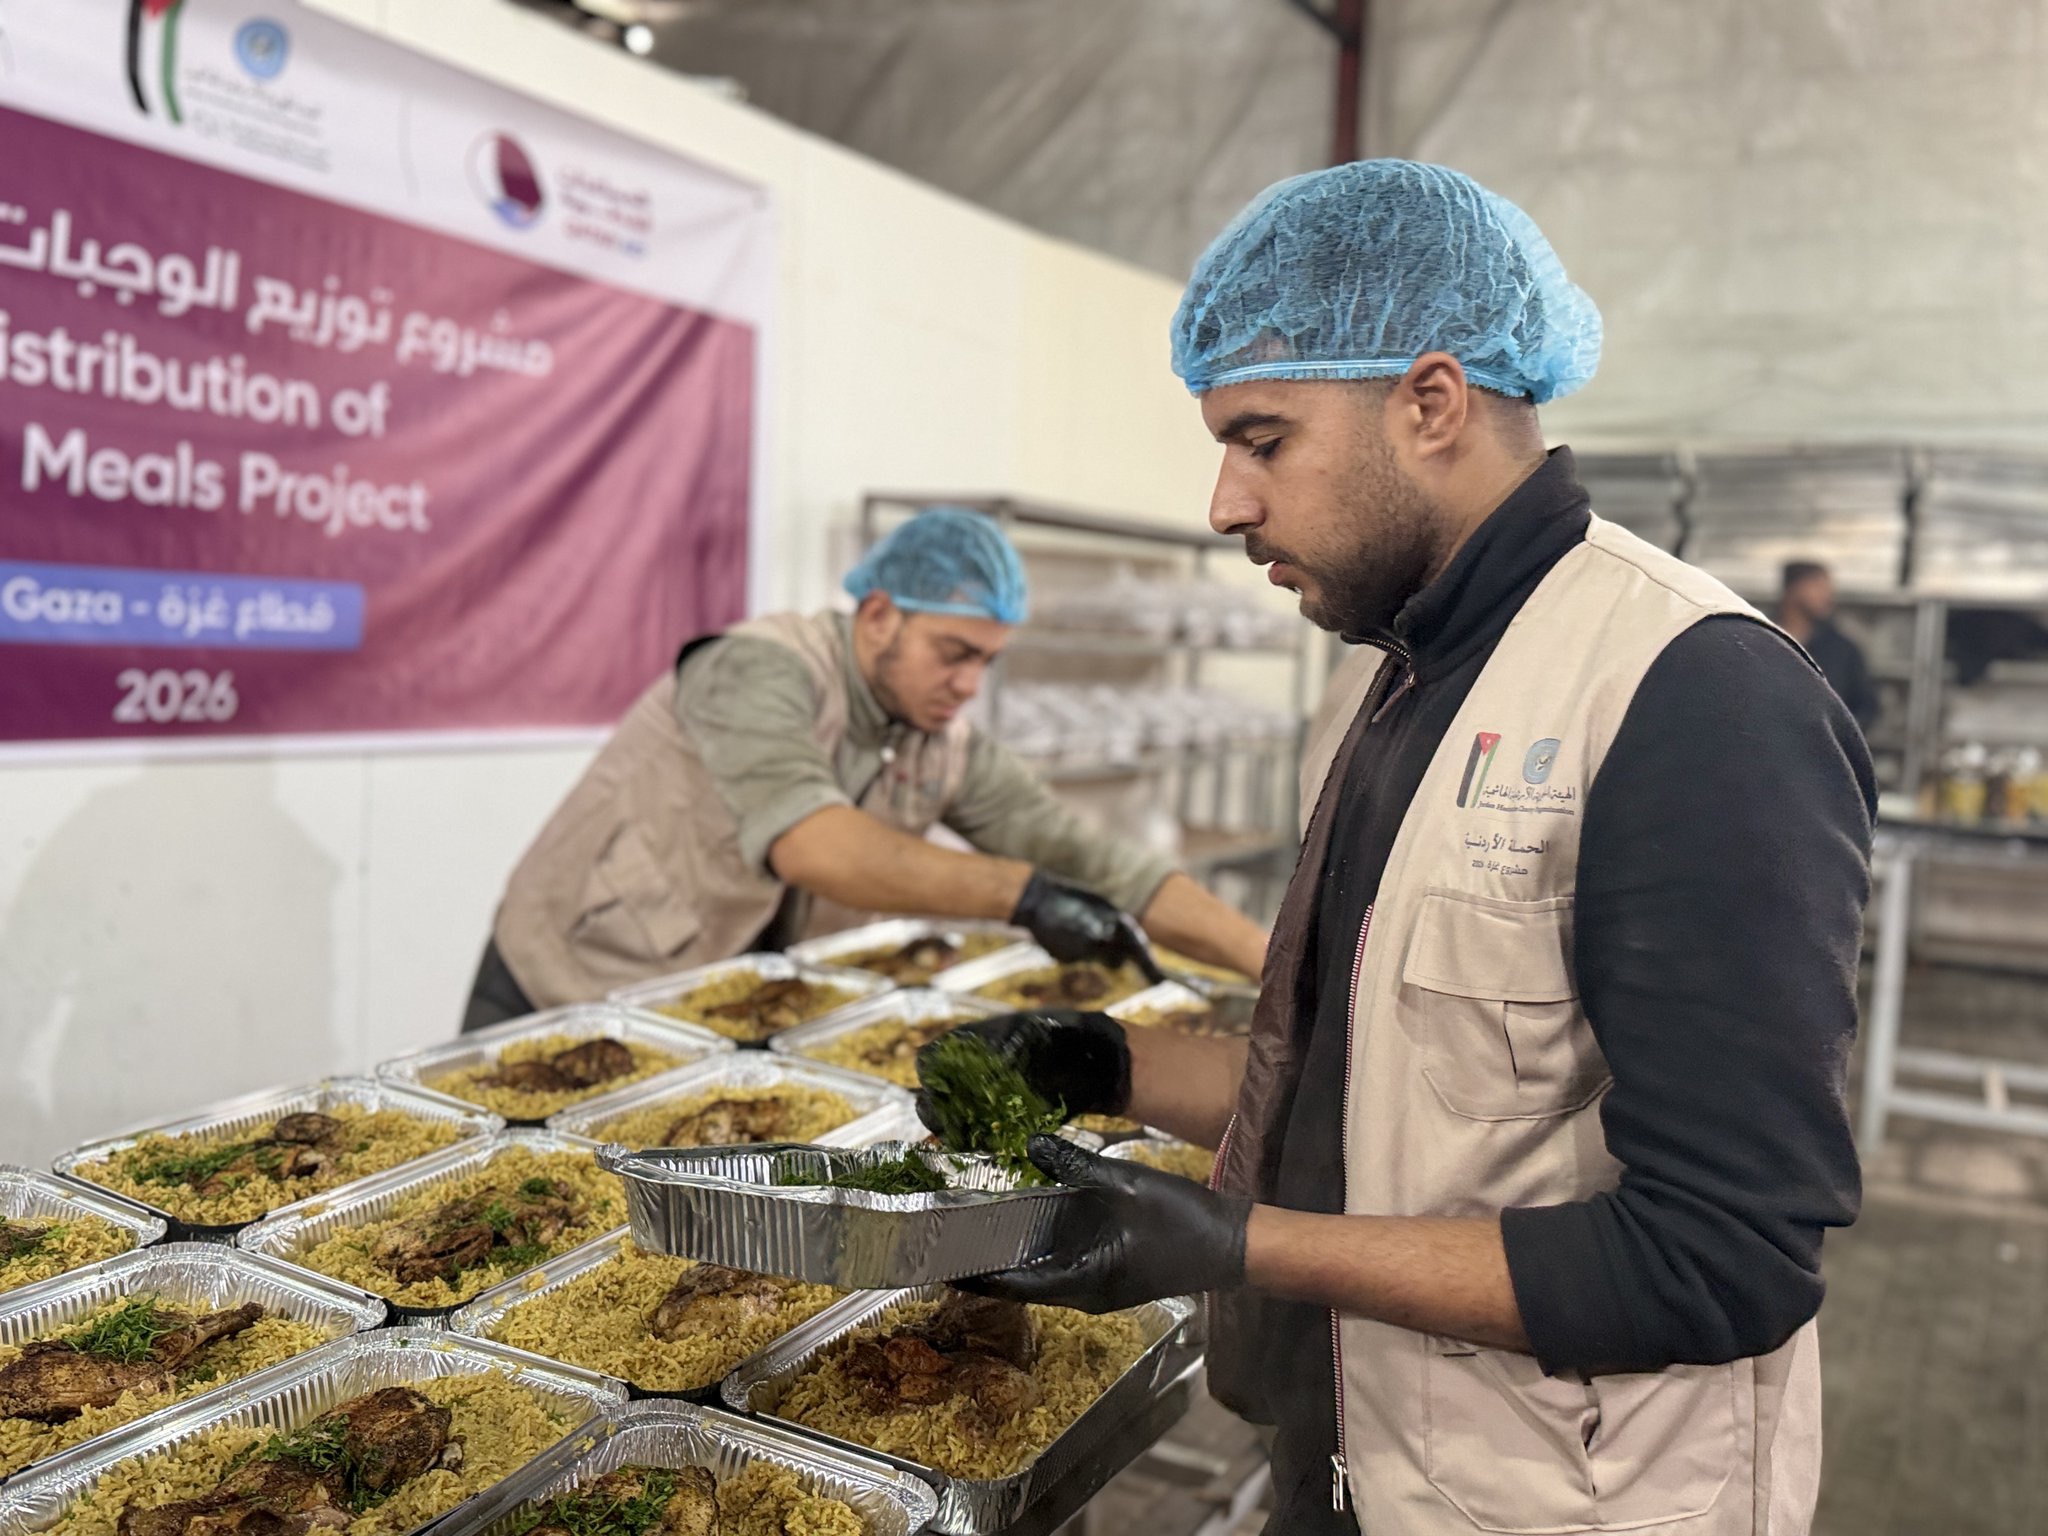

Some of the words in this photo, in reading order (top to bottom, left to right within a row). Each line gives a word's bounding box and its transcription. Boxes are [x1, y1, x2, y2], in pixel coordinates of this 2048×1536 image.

[0, 203, 242, 317] الوجبات
[246, 274, 396, 353] توزيع
[395, 307, 556, 379] مشروع
[0, 311, 321, 429] istribution
[330, 379, 390, 440] of
[21, 422, 226, 512] Meals
[239, 451, 432, 538] Project
[1, 575, 123, 625] Gaza
[157, 584, 229, 639] غزة
[113, 668, 239, 722] 2026
